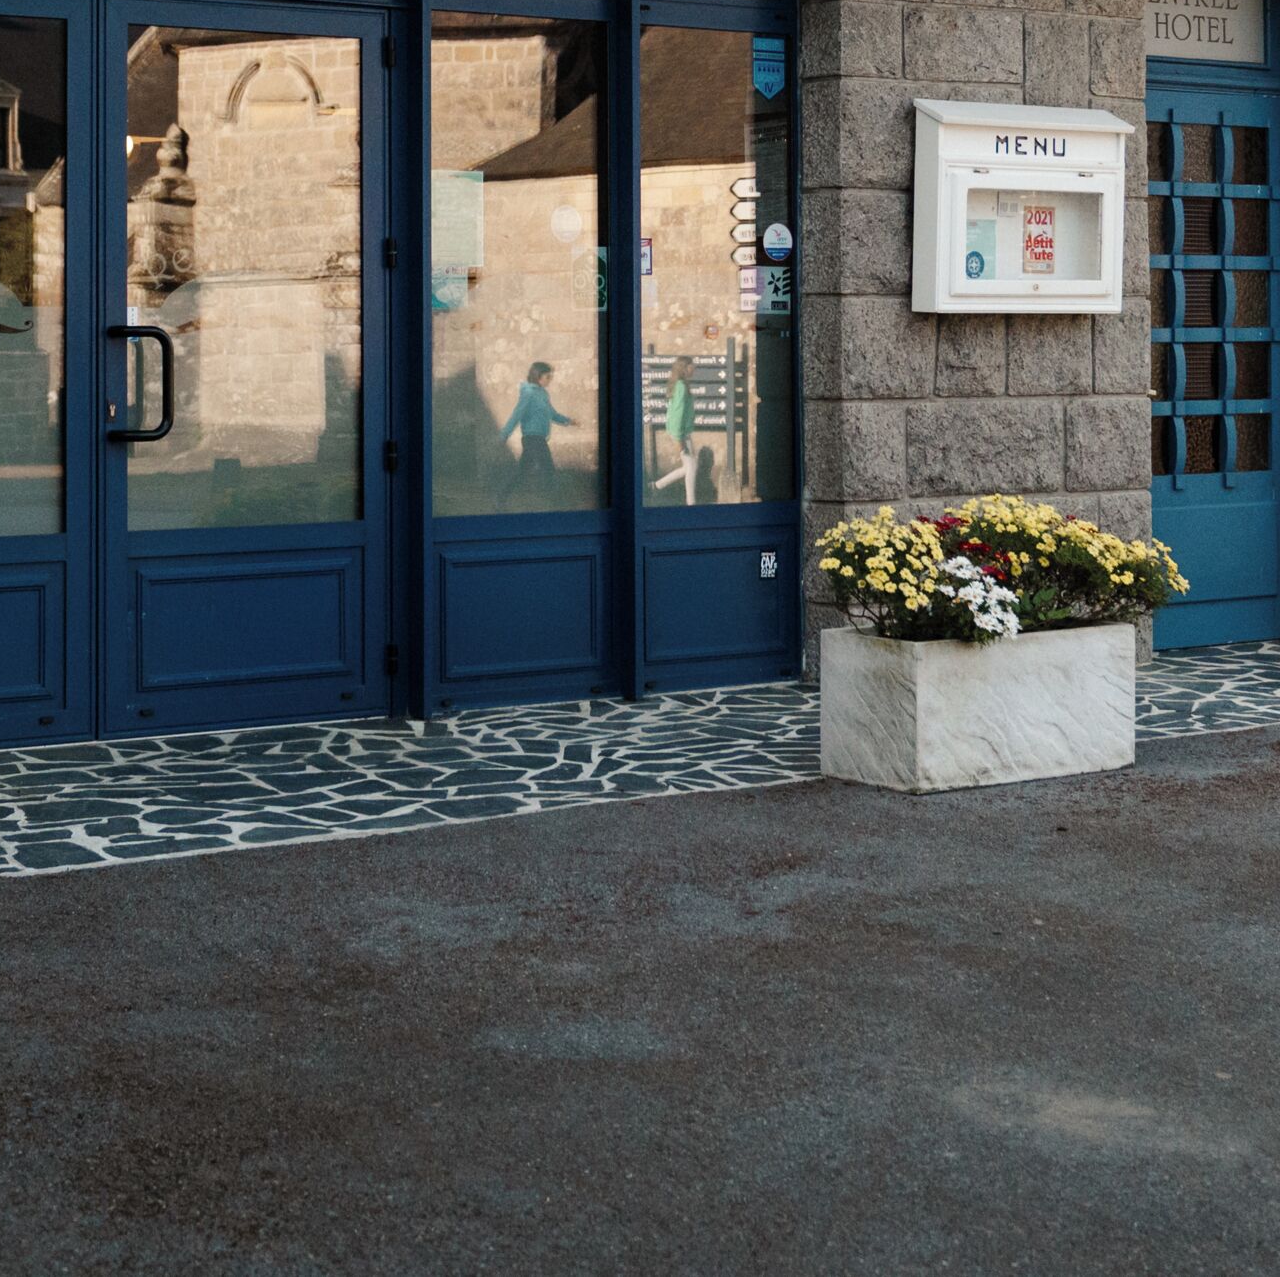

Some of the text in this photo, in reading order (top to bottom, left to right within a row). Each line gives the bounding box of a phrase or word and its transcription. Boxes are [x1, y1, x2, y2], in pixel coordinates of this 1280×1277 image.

[1154, 12, 1234, 44] HOTEL
[995, 135, 1066, 157] MENU
[1026, 210, 1053, 225] 2021
